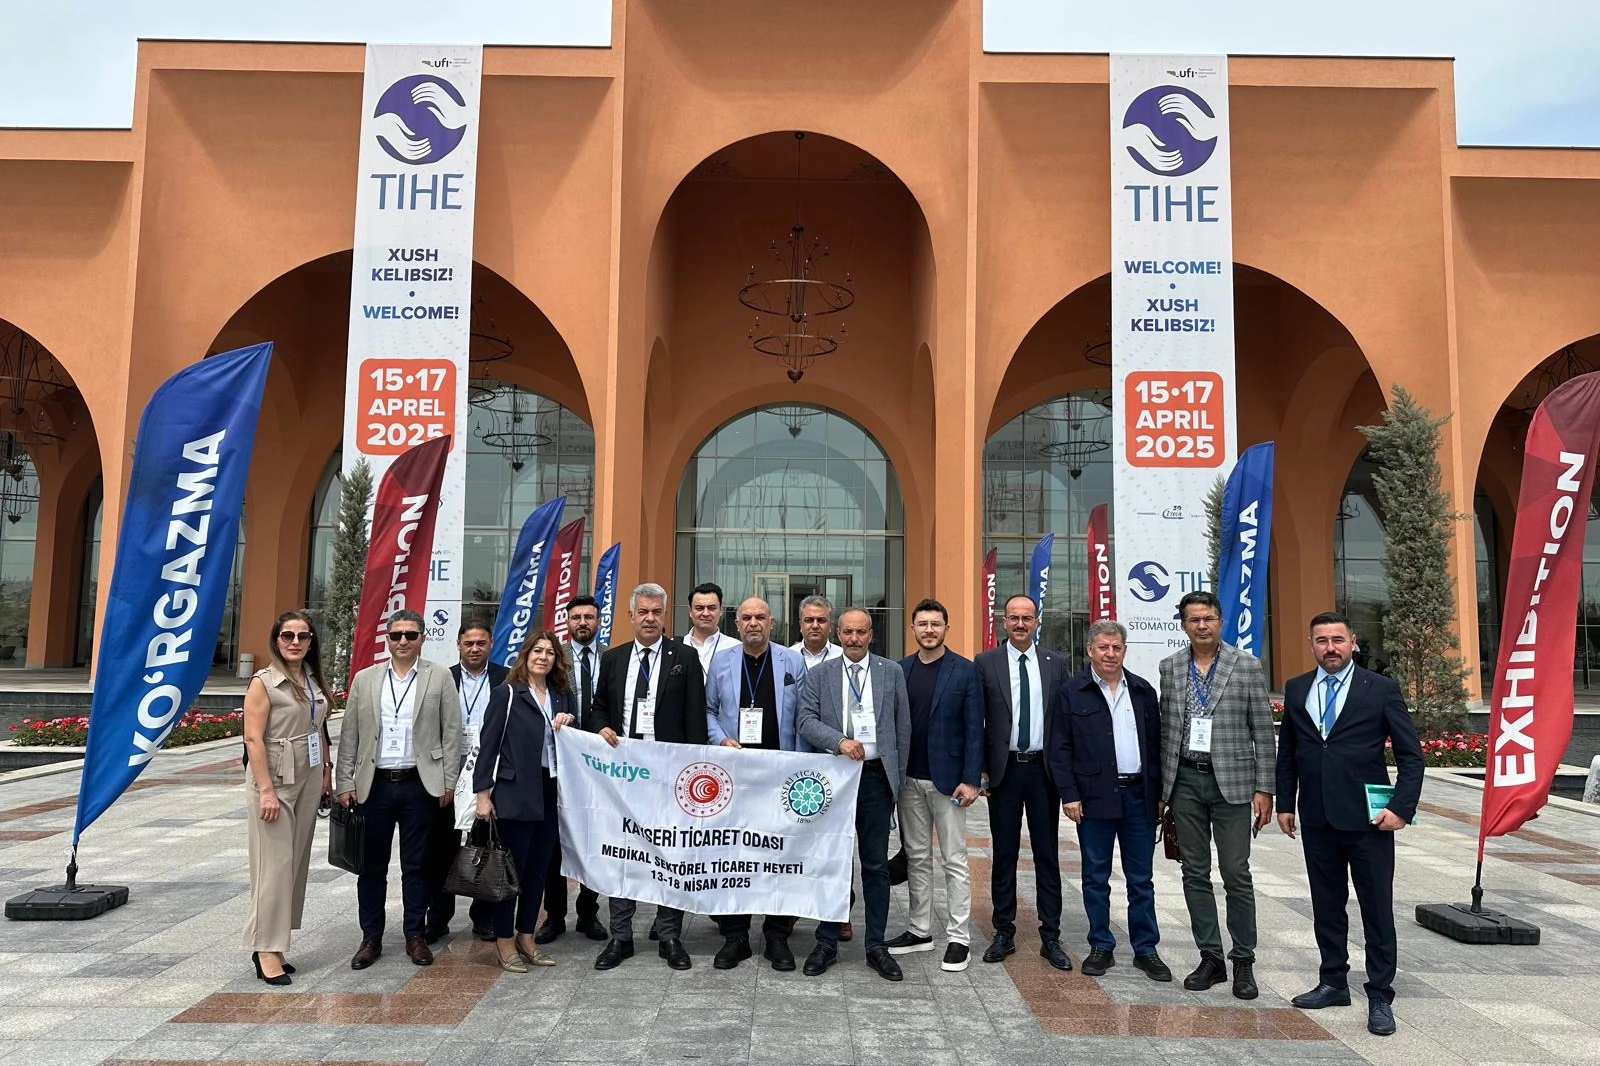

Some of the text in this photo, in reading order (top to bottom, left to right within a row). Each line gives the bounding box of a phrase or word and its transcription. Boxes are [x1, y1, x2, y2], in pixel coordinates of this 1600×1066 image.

[370, 173, 465, 211] TIHE
[1123, 184, 1220, 223] TIHE
[387, 248, 439, 262] XUSH
[371, 267, 453, 282] KELIBSIZ!
[1124, 260, 1222, 275] WELCOME!
[362, 304, 460, 320] WELCOME!
[1146, 298, 1199, 312] XUSH
[1130, 318, 1216, 332] KELIBSIZ!
[367, 398, 446, 417] APREL
[1135, 409, 1215, 430] APRIL
[366, 423, 446, 446] 2025
[1135, 434, 1215, 459] 2025
[430, 559, 451, 581] HE
[1095, 543, 1110, 619] ITION
[1175, 571, 1212, 592] TIH
[553, 551, 572, 646] HIBITION
[425, 627, 445, 637] XPO
[1128, 621, 1184, 632] STOMATOL
[581, 752, 651, 783] Türkiye
[680, 825, 741, 848] TİCARET
[742, 830, 784, 851] ODASI
[601, 843, 804, 877] MEDİKAL SEKTÖREL TİCARET HEYETİ
[650, 869, 751, 892] 13-18 NİSAN 2025
